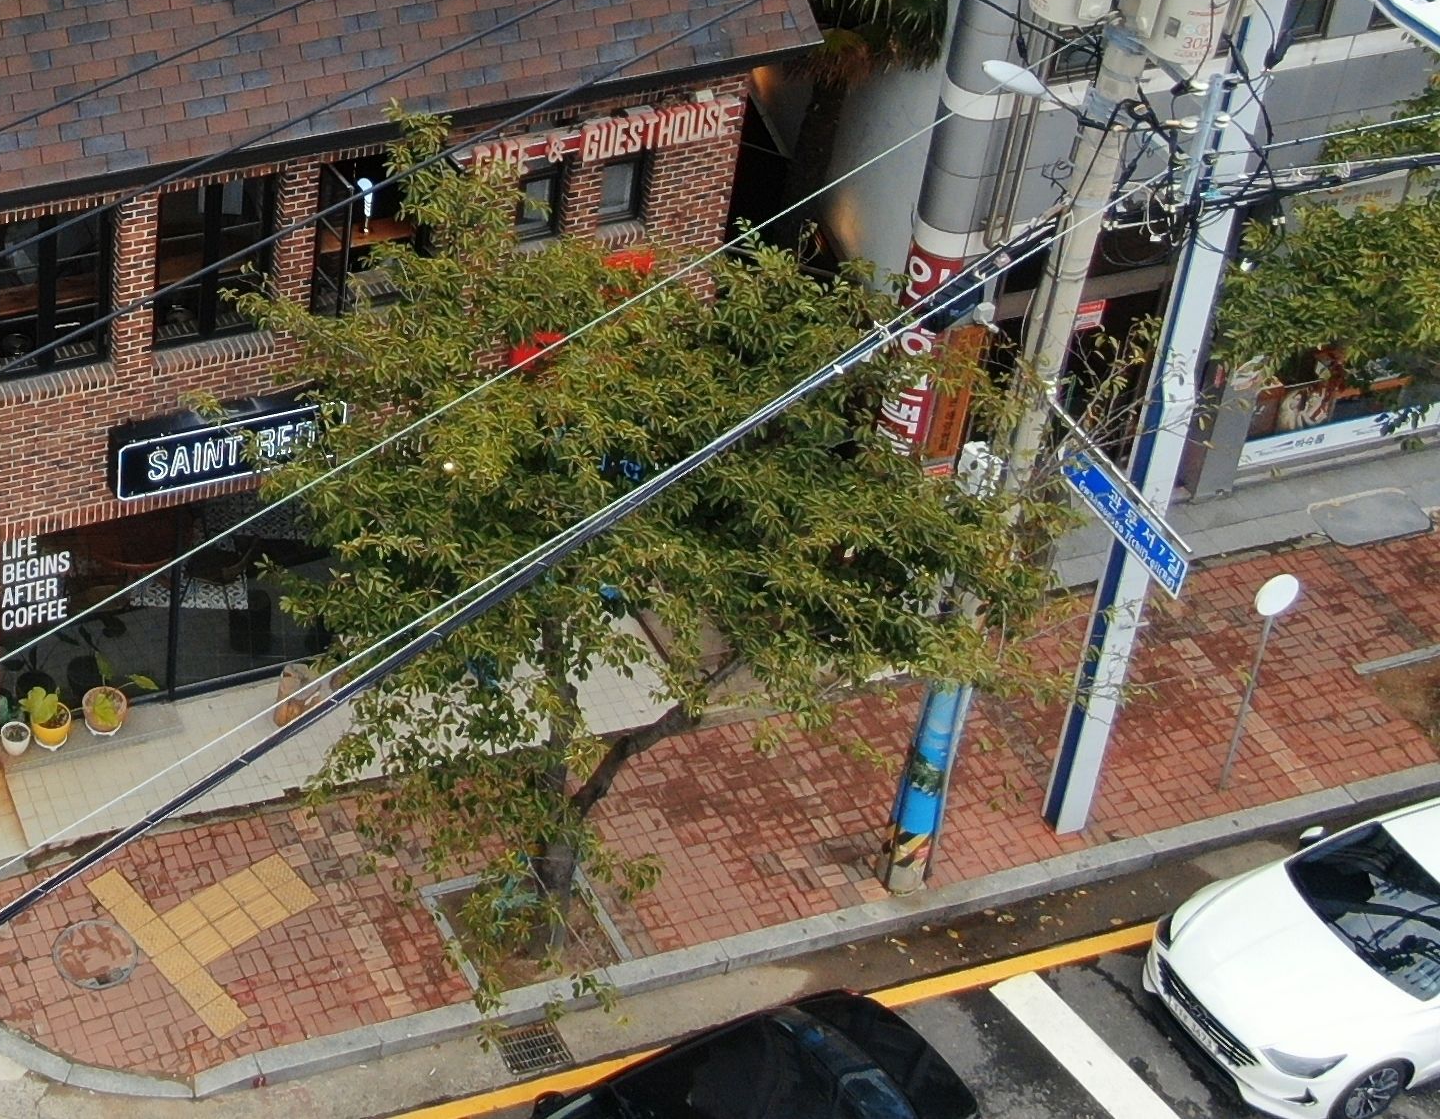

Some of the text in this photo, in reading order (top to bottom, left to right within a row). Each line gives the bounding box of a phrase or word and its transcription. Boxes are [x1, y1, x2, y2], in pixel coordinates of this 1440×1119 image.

[546, 136, 565, 163] &
[581, 105, 736, 162] GUESTHOUSE
[147, 435, 244, 481] SAINT
[2, 535, 38, 561] LIFE
[2, 550, 71, 585] BEGINS
[1, 577, 58, 609] AFTER
[1, 597, 68, 631] COFFEE
